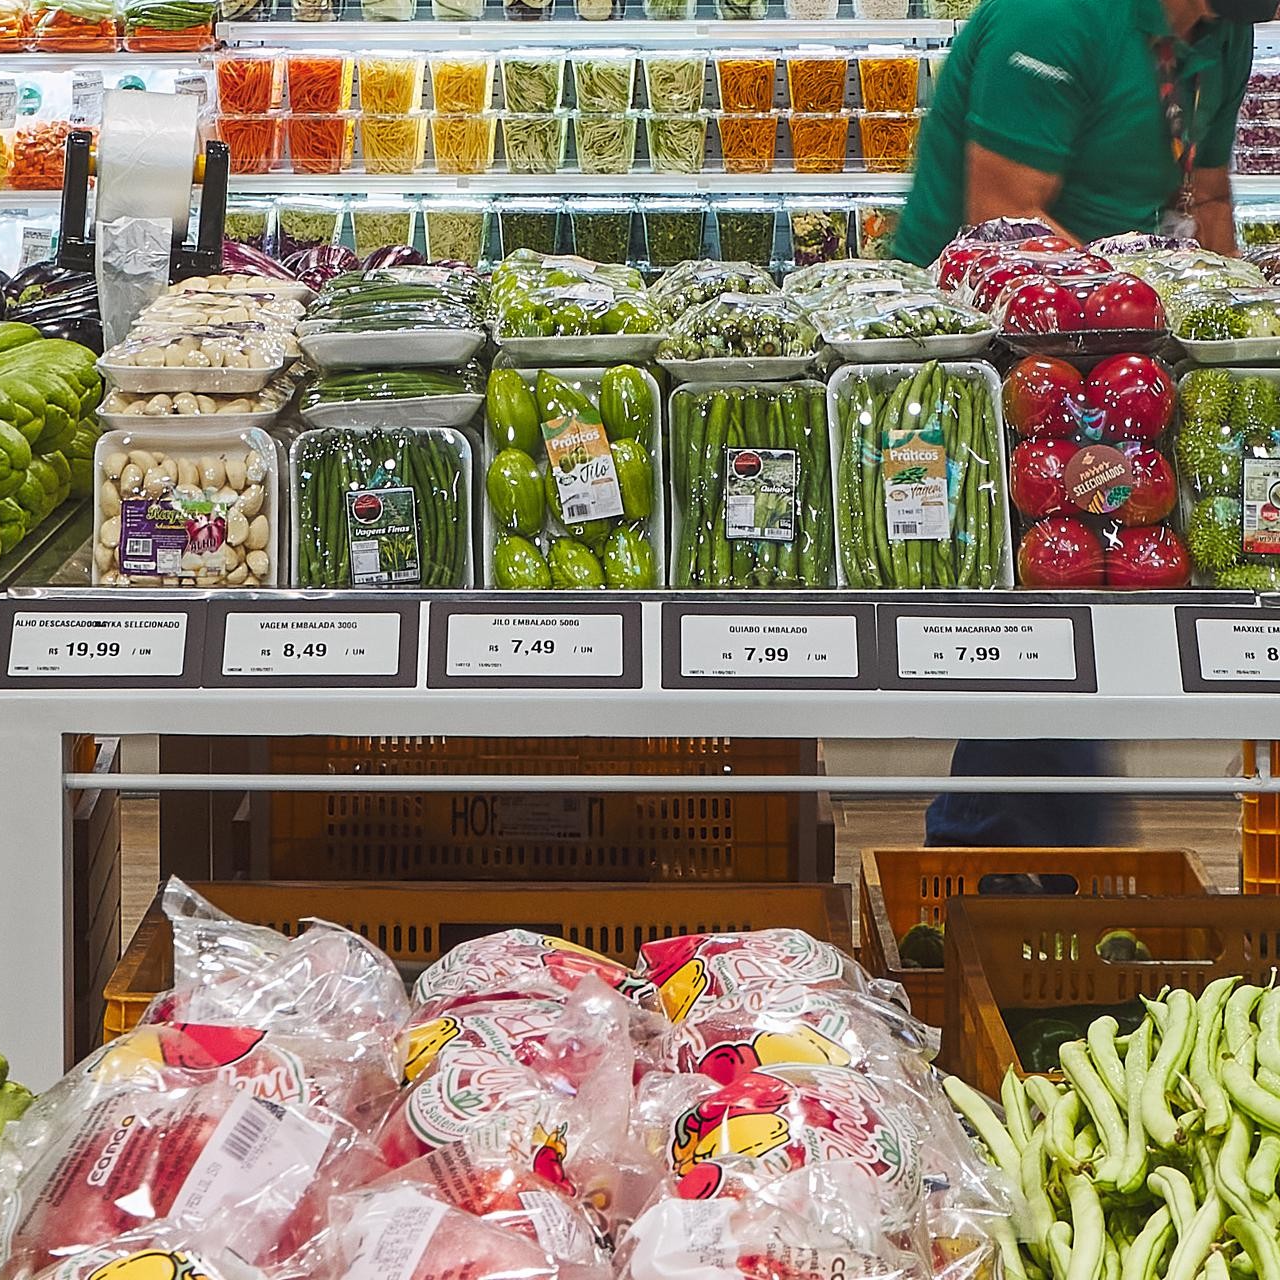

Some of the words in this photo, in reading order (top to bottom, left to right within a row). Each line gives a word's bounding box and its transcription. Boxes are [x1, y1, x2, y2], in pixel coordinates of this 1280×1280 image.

[551, 430, 600, 451] Práticos
[890, 449, 939, 461] Práticos
[1073, 463, 1126, 497] SELECIONADOS
[760, 484, 791, 494] Quiabo
[355, 527, 386, 537] Vagens
[387, 525, 410, 534] Finas
[15, 620, 37, 628] ALHO
[124, 621, 180, 629] SELECIONADO
[259, 621, 288, 629] VAGEM
[291, 621, 335, 629] EMBALADA
[337, 621, 358, 630] 300G
[512, 618, 557, 627] EMBALADO
[559, 619, 580, 627] 500G
[729, 625, 760, 634] QUIABO
[763, 626, 808, 634] EMBALADO
[923, 625, 952, 634] VAGEM
[1003, 625, 1019, 633] 300
[1021, 625, 1033, 633] GR
[1233, 625, 1264, 634] MAXIXE
[48, 648, 59, 656] R$
[65, 642, 120, 659] 19,99
[139, 648, 152, 656] UN
[261, 648, 270, 657] R$
[283, 643, 328, 659] 8,49
[352, 648, 365, 656] UN
[488, 644, 499, 652] R$
[510, 639, 556, 656] 7,49
[580, 645, 593, 653] UN
[722, 652, 733, 660] R$
[744, 647, 789, 663] 7,99
[814, 653, 827, 661] UN
[933, 652, 944, 660] R$
[954, 646, 1000, 663] 7,99
[1026, 652, 1039, 660] UN
[1245, 651, 1256, 660] R$
